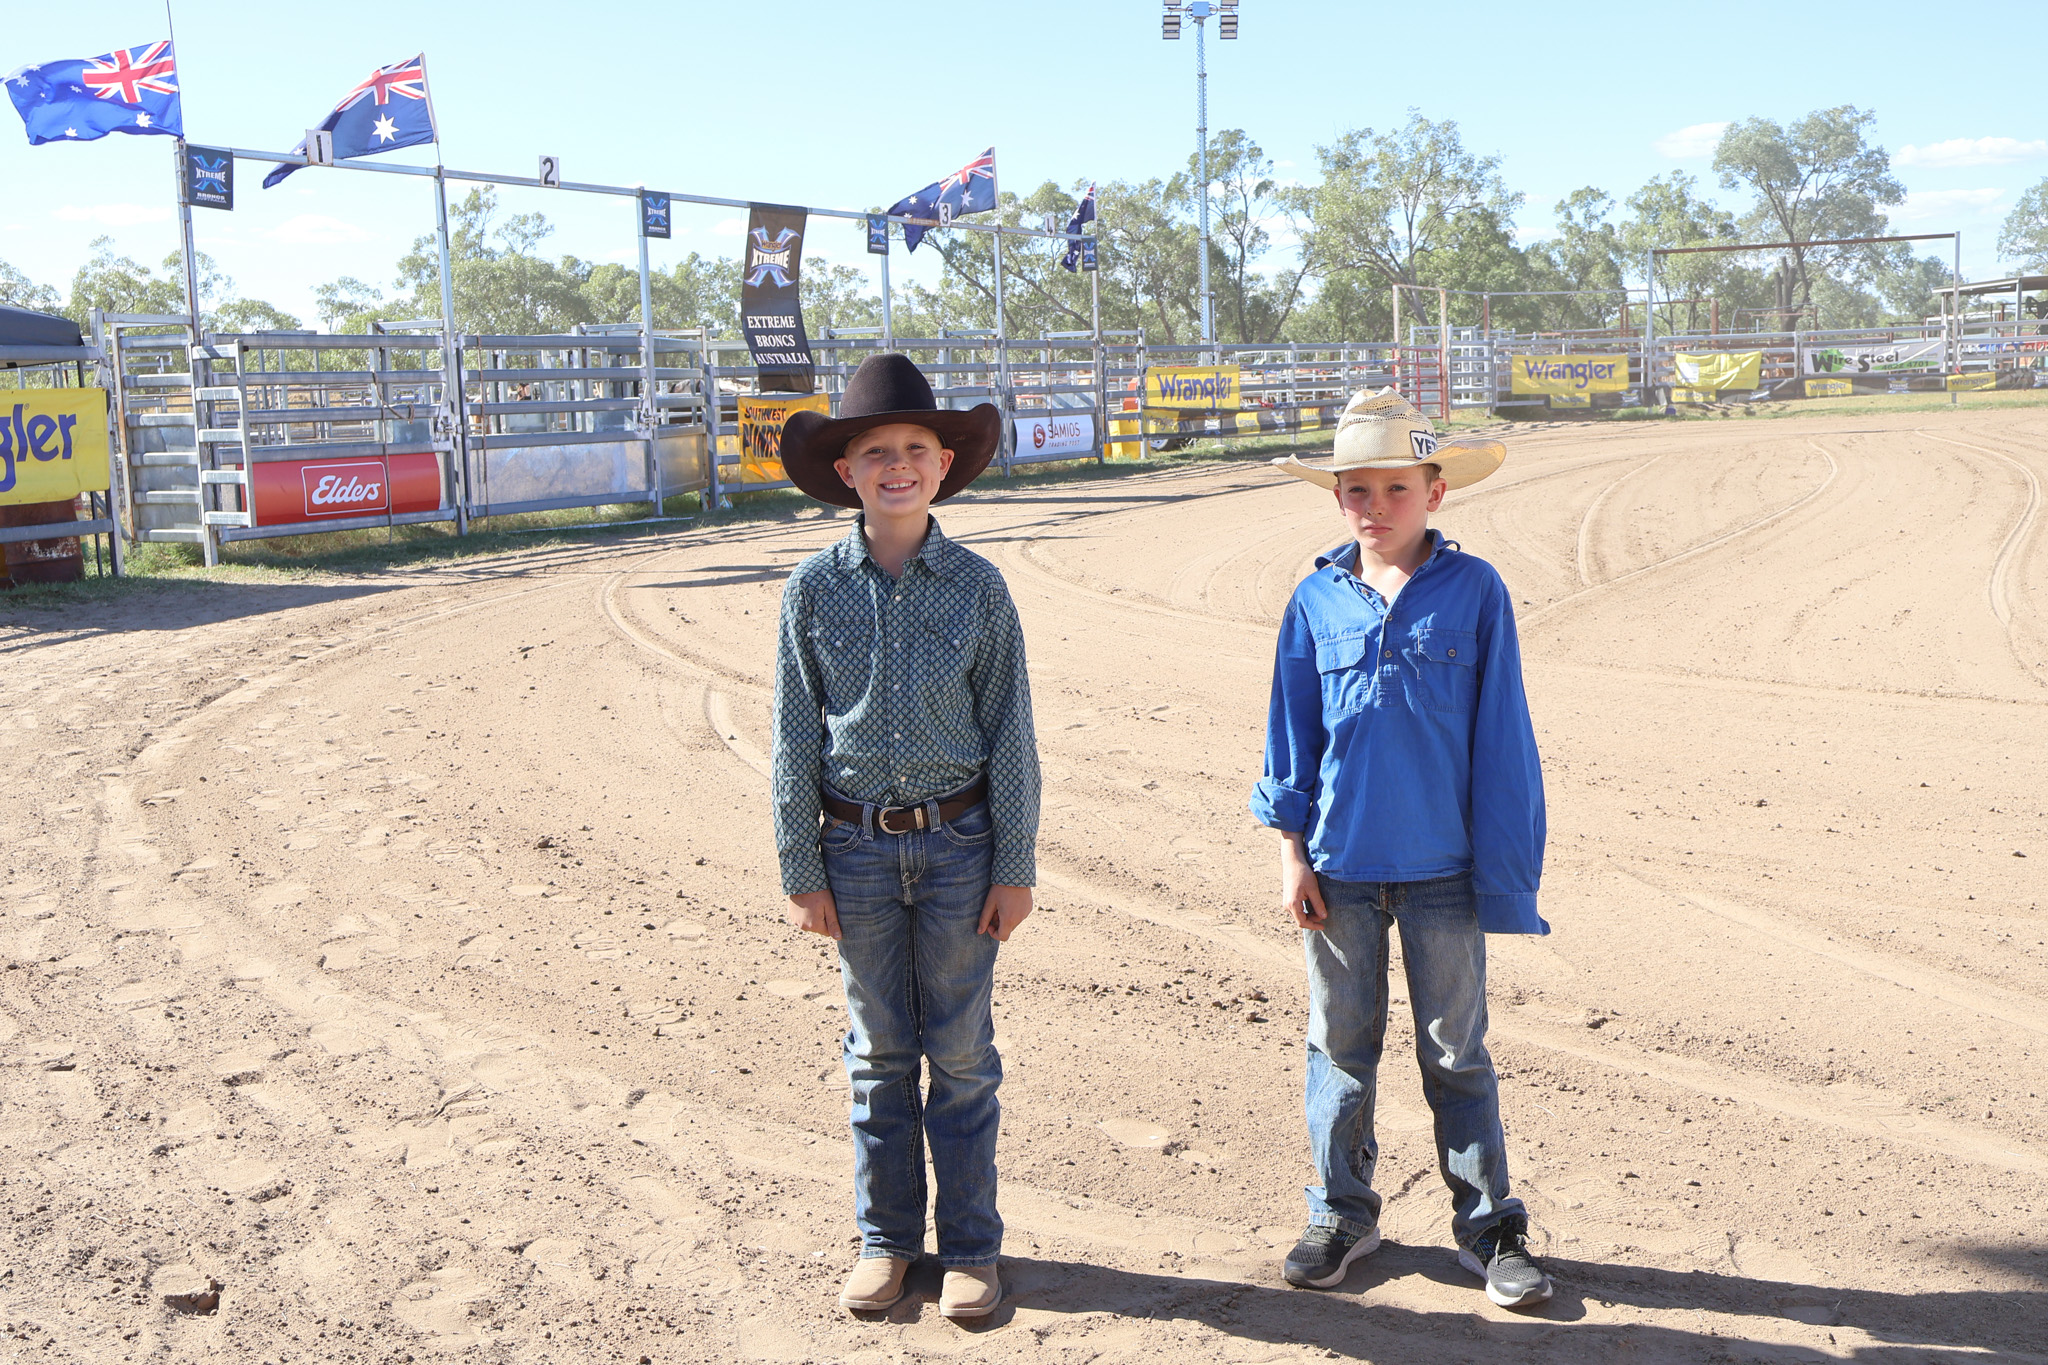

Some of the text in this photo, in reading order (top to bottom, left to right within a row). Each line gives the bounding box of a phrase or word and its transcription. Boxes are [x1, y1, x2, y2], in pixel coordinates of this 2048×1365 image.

[196, 167, 226, 183] XTREME
[542, 157, 556, 186] 2
[942, 204, 949, 225] 3
[751, 247, 791, 269] XTREME
[746, 315, 796, 329] EXTREME
[754, 334, 796, 348] BRONCS
[755, 352, 811, 365] AUSTRALIA
[1811, 350, 1899, 373] Wire Steel
[1524, 359, 1616, 389] Wrangler
[1156, 371, 1233, 409] Wrangler
[1808, 381, 1847, 393] Wrangler
[1047, 422, 1081, 439] SAMIOS
[0, 403, 77, 493] ler
[1413, 436, 1438, 456] YET
[311, 475, 381, 505] Elders
